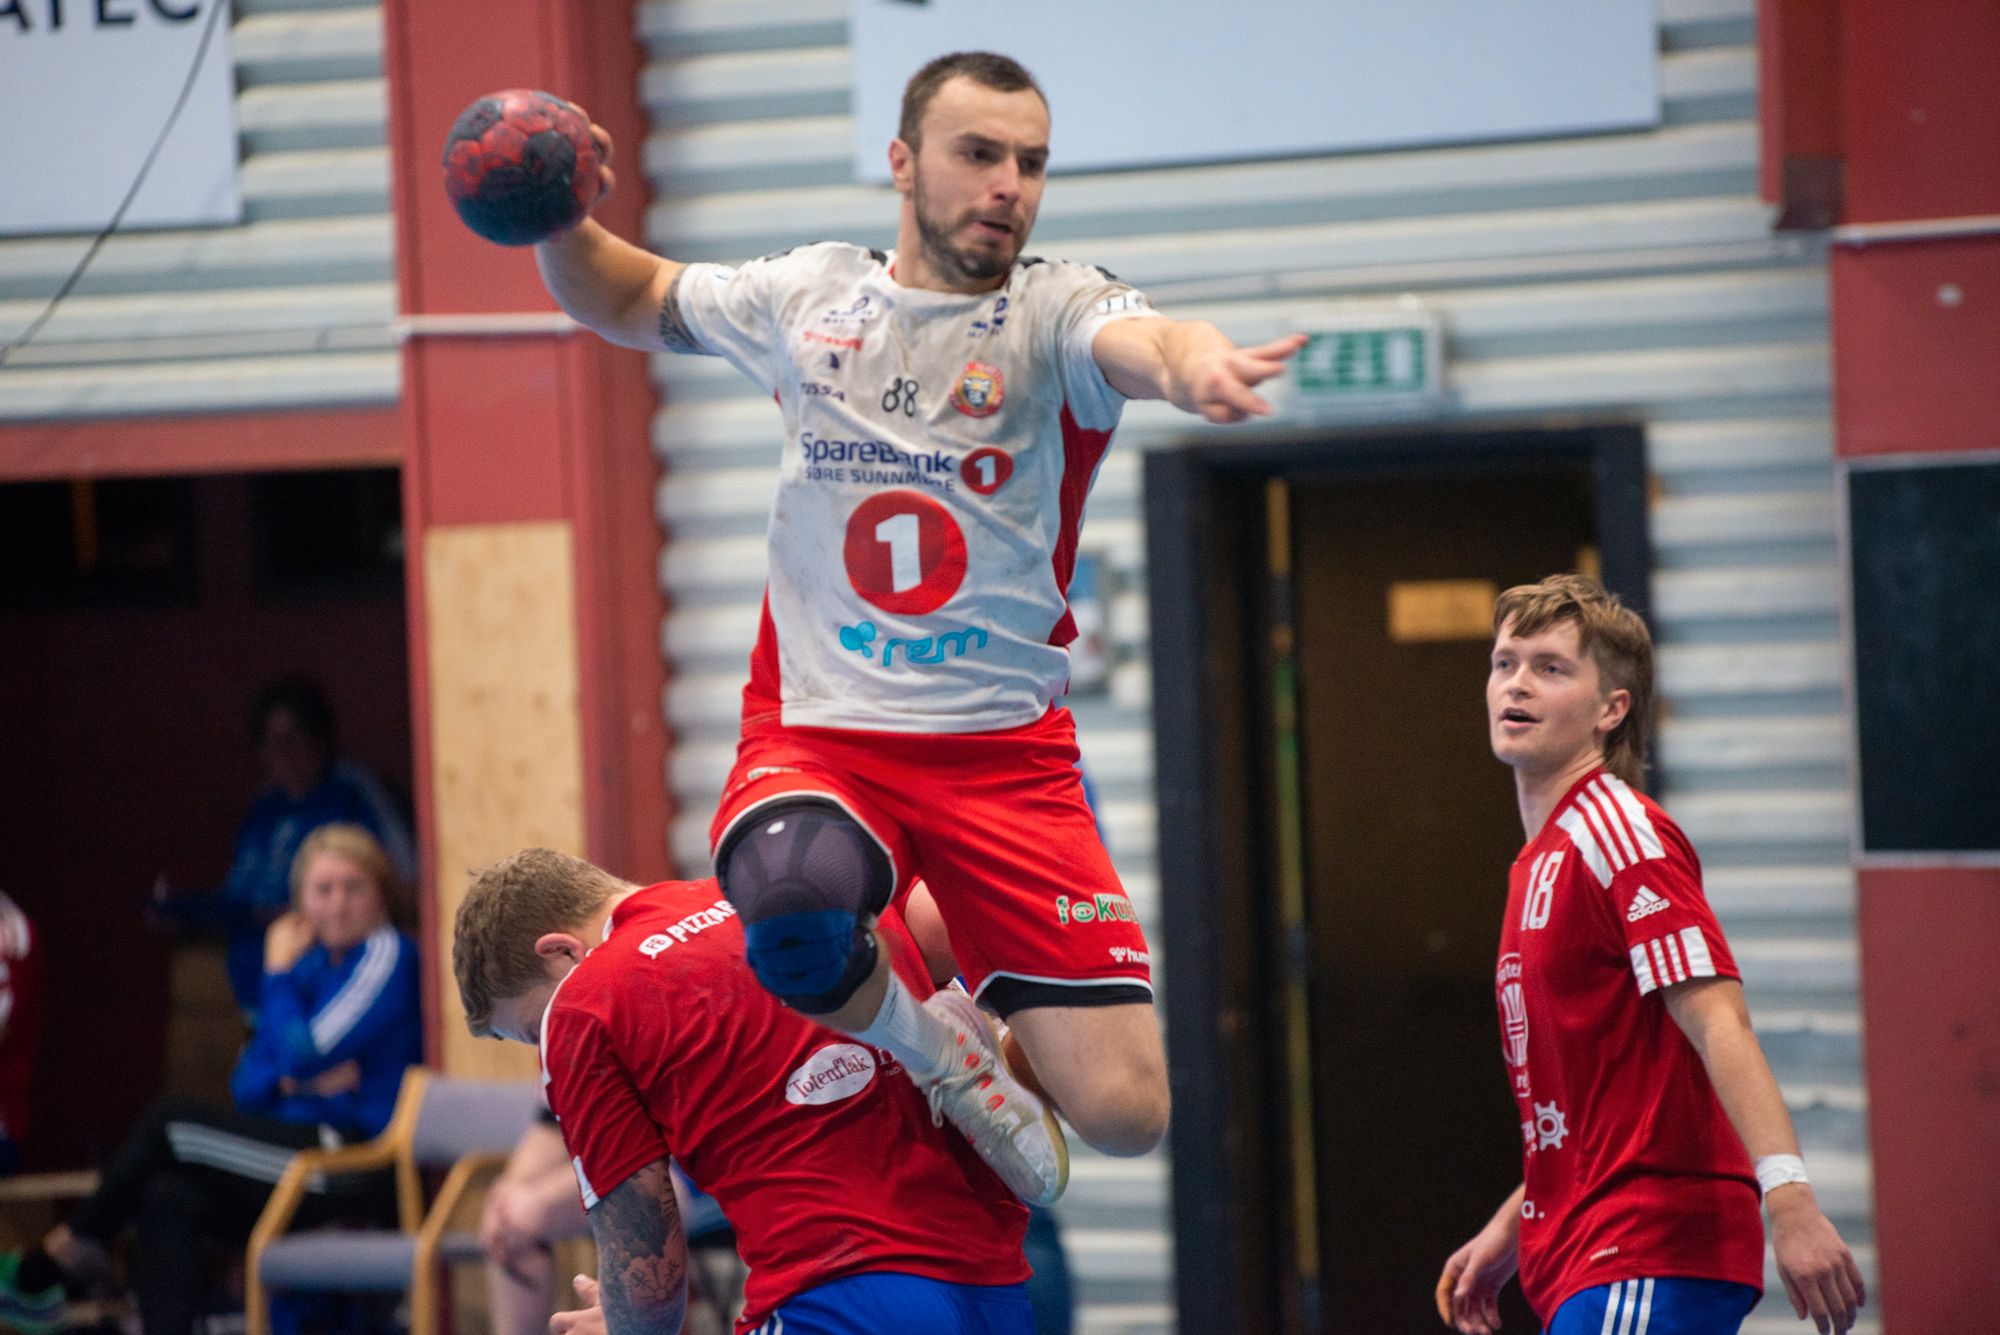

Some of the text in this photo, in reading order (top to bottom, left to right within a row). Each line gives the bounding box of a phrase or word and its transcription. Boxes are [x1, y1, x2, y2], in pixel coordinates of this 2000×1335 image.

[850, 468, 955, 492] SUNNME
[974, 455, 996, 487] 1
[875, 513, 923, 594] 1
[883, 626, 988, 668] rem
[1520, 850, 1565, 932] 18
[1627, 898, 1671, 922] adidas
[788, 1053, 871, 1098] Totenflak
